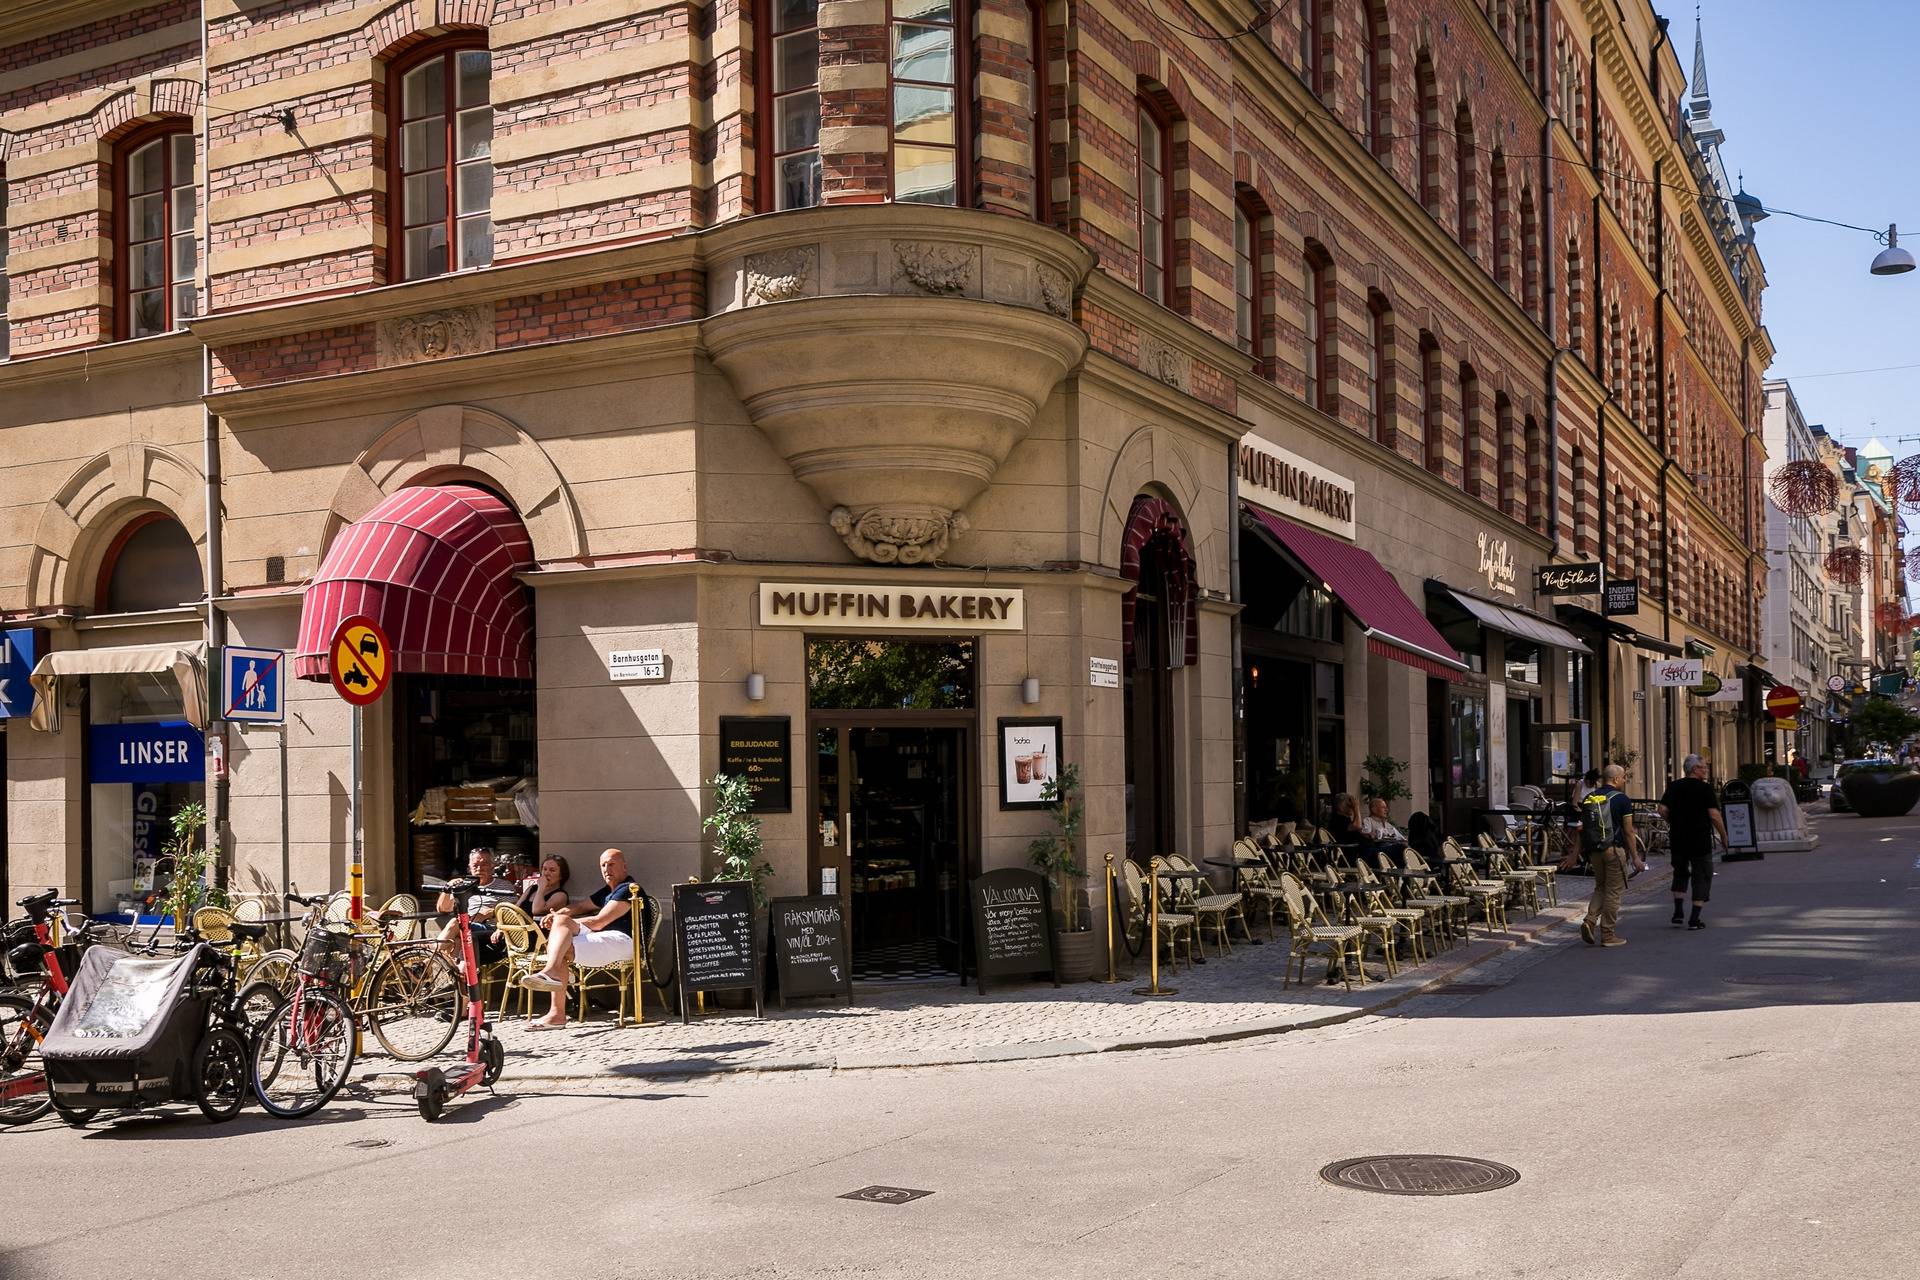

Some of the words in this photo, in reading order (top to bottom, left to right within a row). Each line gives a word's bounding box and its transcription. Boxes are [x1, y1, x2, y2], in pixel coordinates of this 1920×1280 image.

[1237, 440, 1298, 501] MUFFIN
[1299, 471, 1354, 523] BAKERY
[1542, 569, 1597, 590] Vinfolket
[1608, 586, 1635, 594] INDIAN
[772, 591, 890, 618] MUFFIN
[899, 594, 1016, 620] BAKERY
[1609, 601, 1627, 609] FOOD
[612, 654, 659, 664] Barnhusgatan
[1664, 670, 1698, 681] SPOT
[730, 740, 780, 748] ERBJUDANDE
[119, 740, 189, 765] LINSER
